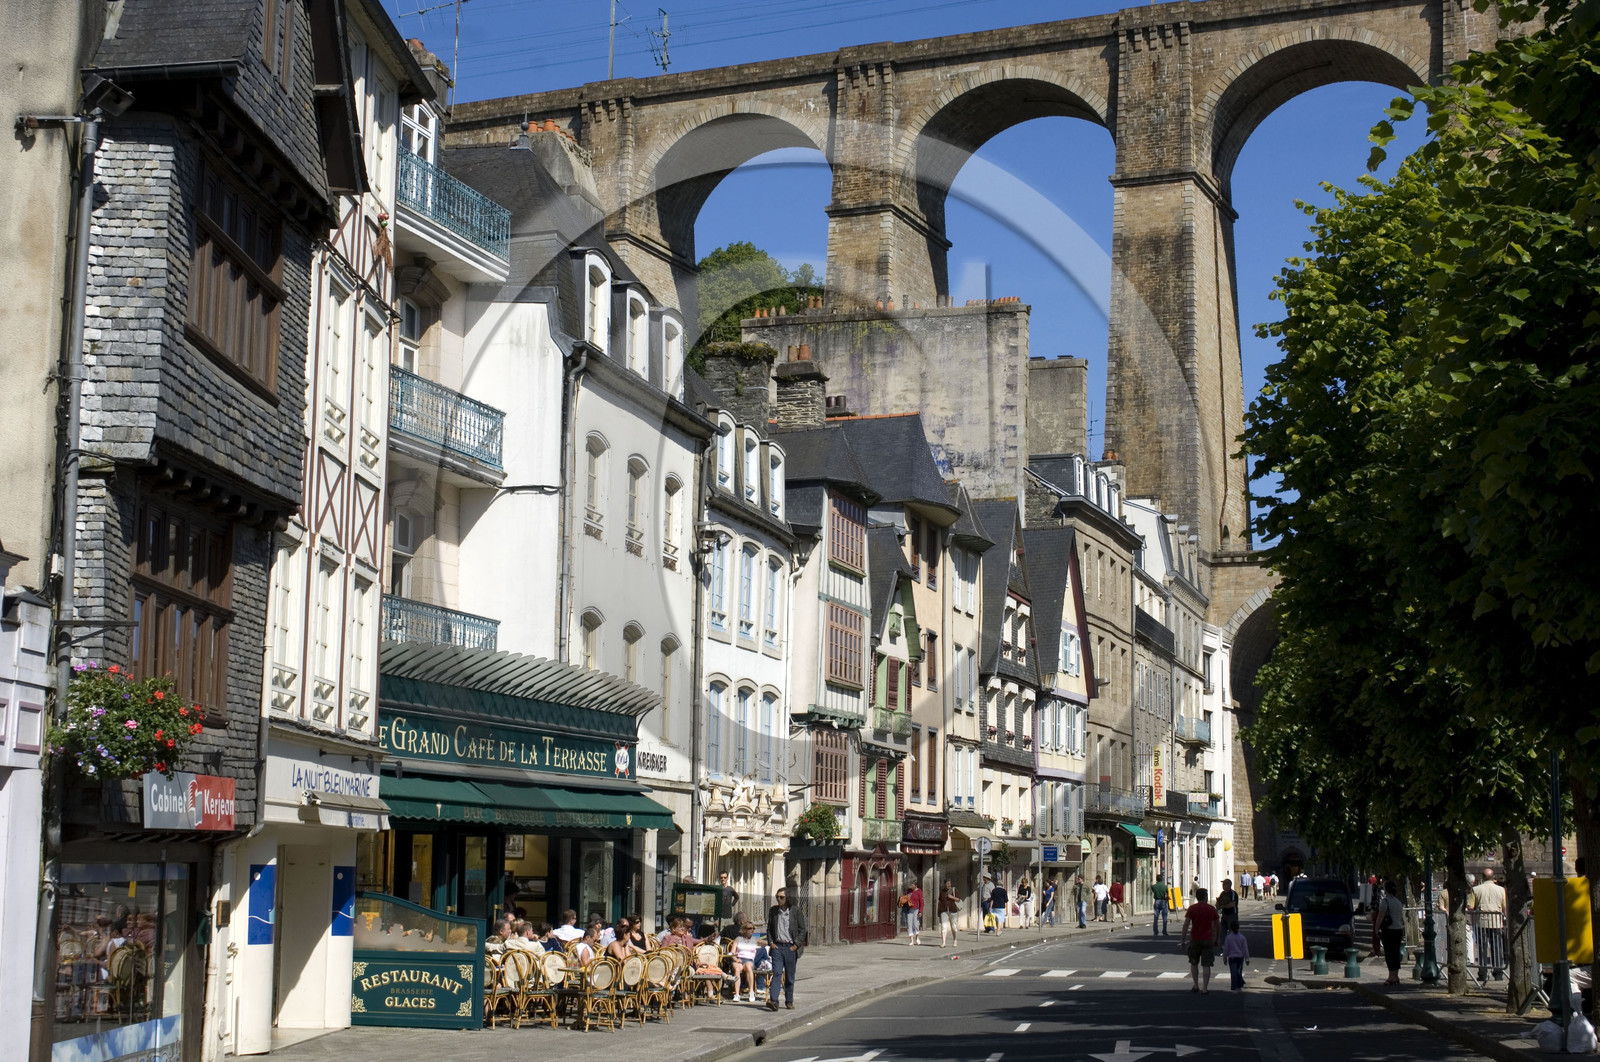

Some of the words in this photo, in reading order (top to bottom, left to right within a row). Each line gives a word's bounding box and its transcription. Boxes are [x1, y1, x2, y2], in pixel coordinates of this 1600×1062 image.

[378, 726, 388, 749] E
[391, 717, 449, 755] GRAND
[454, 725, 495, 760] CAFÉ
[499, 741, 516, 762] DE
[520, 744, 538, 765] LA
[542, 736, 607, 772] TERRASSE
[637, 751, 668, 773] KREISKER
[292, 763, 303, 788] LA
[303, 768, 323, 790] NUIT
[324, 771, 344, 794] BLEU
[344, 775, 373, 797] MARINE
[1154, 769, 1163, 800] Kodak
[151, 783, 187, 813] Cabinet
[204, 789, 234, 822] Kerjean
[464, 806, 483, 819] BAR
[360, 969, 464, 995] RESTAURANT
[390, 987, 433, 996] BRASSERIE
[384, 996, 436, 1009] GLACES
